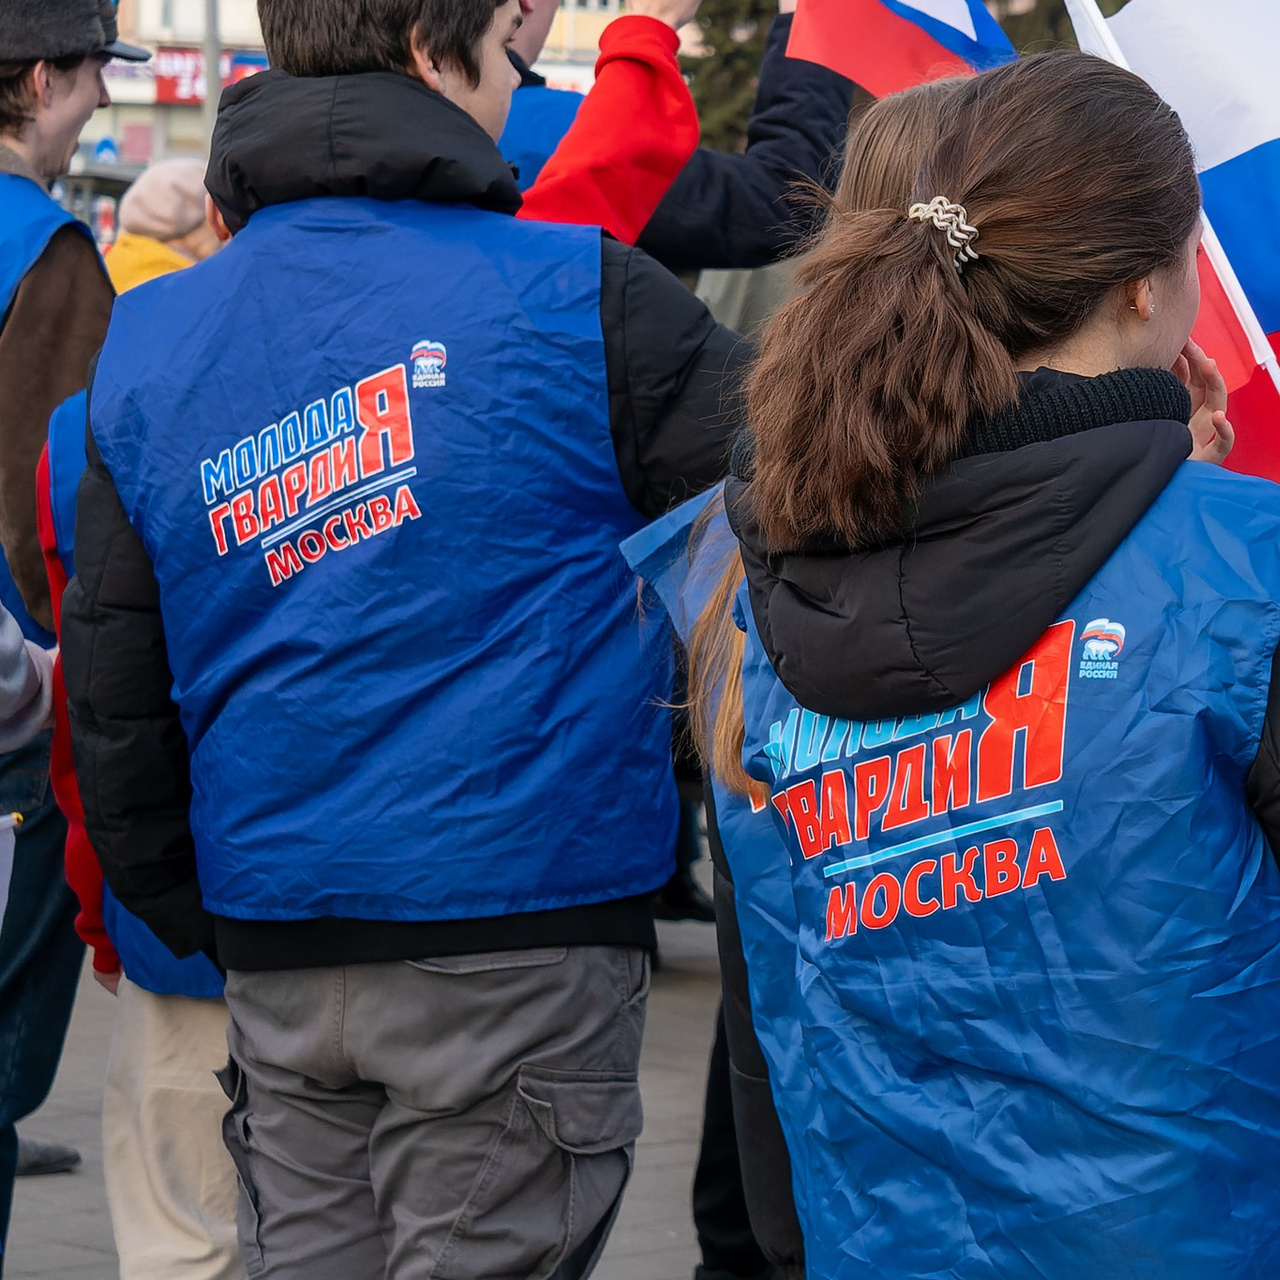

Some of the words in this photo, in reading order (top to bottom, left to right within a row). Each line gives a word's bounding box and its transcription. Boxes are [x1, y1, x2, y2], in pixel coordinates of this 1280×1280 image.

[263, 484, 422, 588] МОСКВА
[1078, 669, 1118, 680] РОССИЯ
[1079, 660, 1119, 671] ЕДИНАЯ
[824, 826, 1067, 942] МОСКВА
